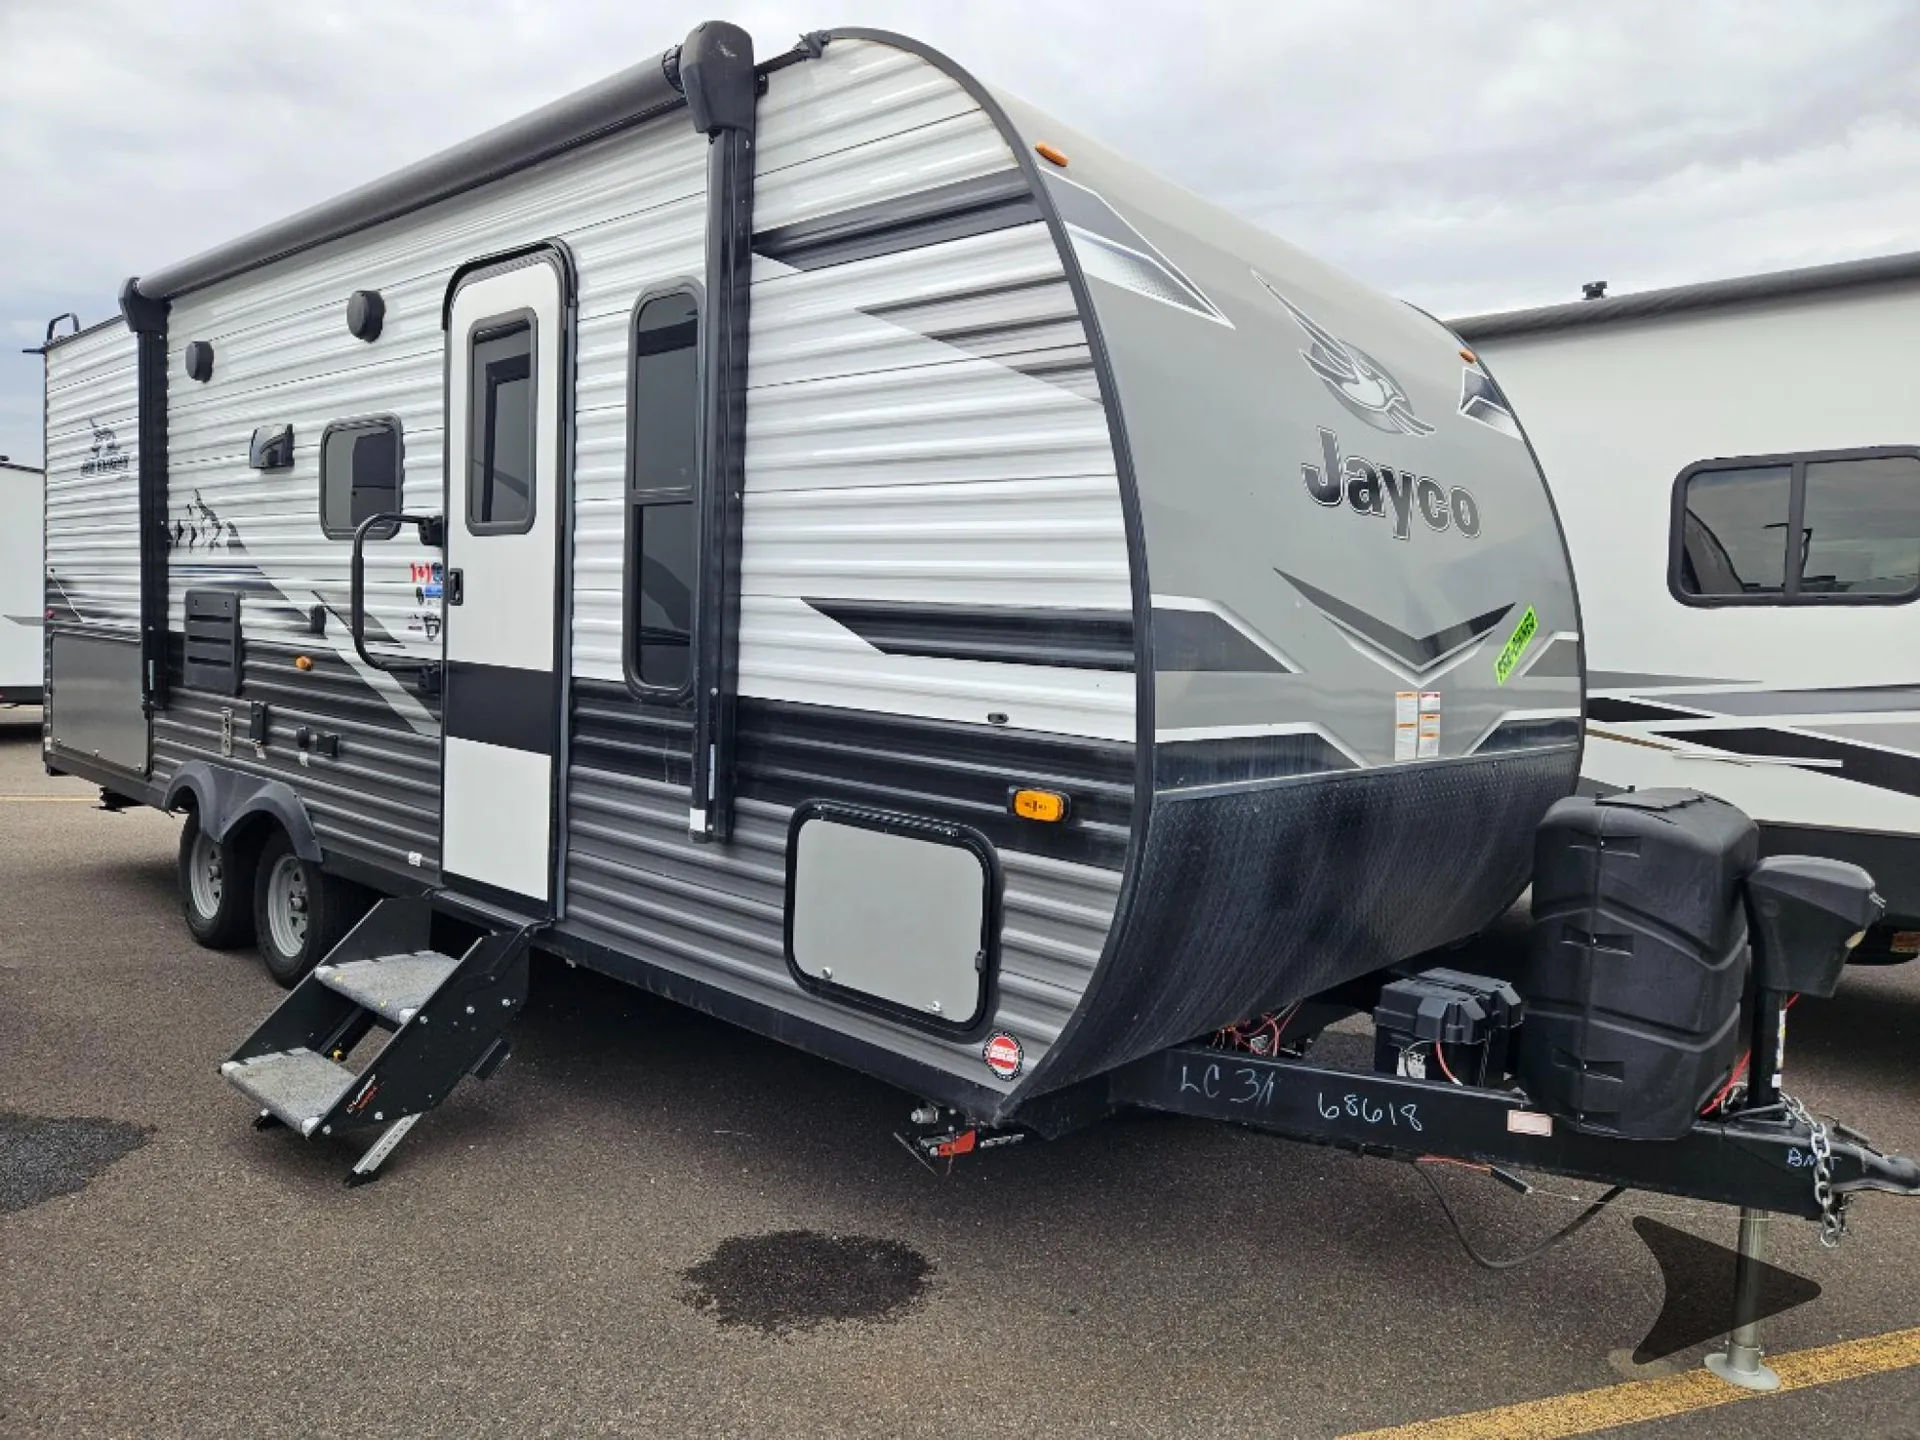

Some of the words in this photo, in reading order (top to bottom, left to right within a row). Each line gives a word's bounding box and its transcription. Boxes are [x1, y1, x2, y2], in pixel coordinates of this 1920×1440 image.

[1300, 426, 1482, 541] Jayco
[1179, 1063, 1220, 1098] LC
[1317, 1092, 1423, 1131] 68618
